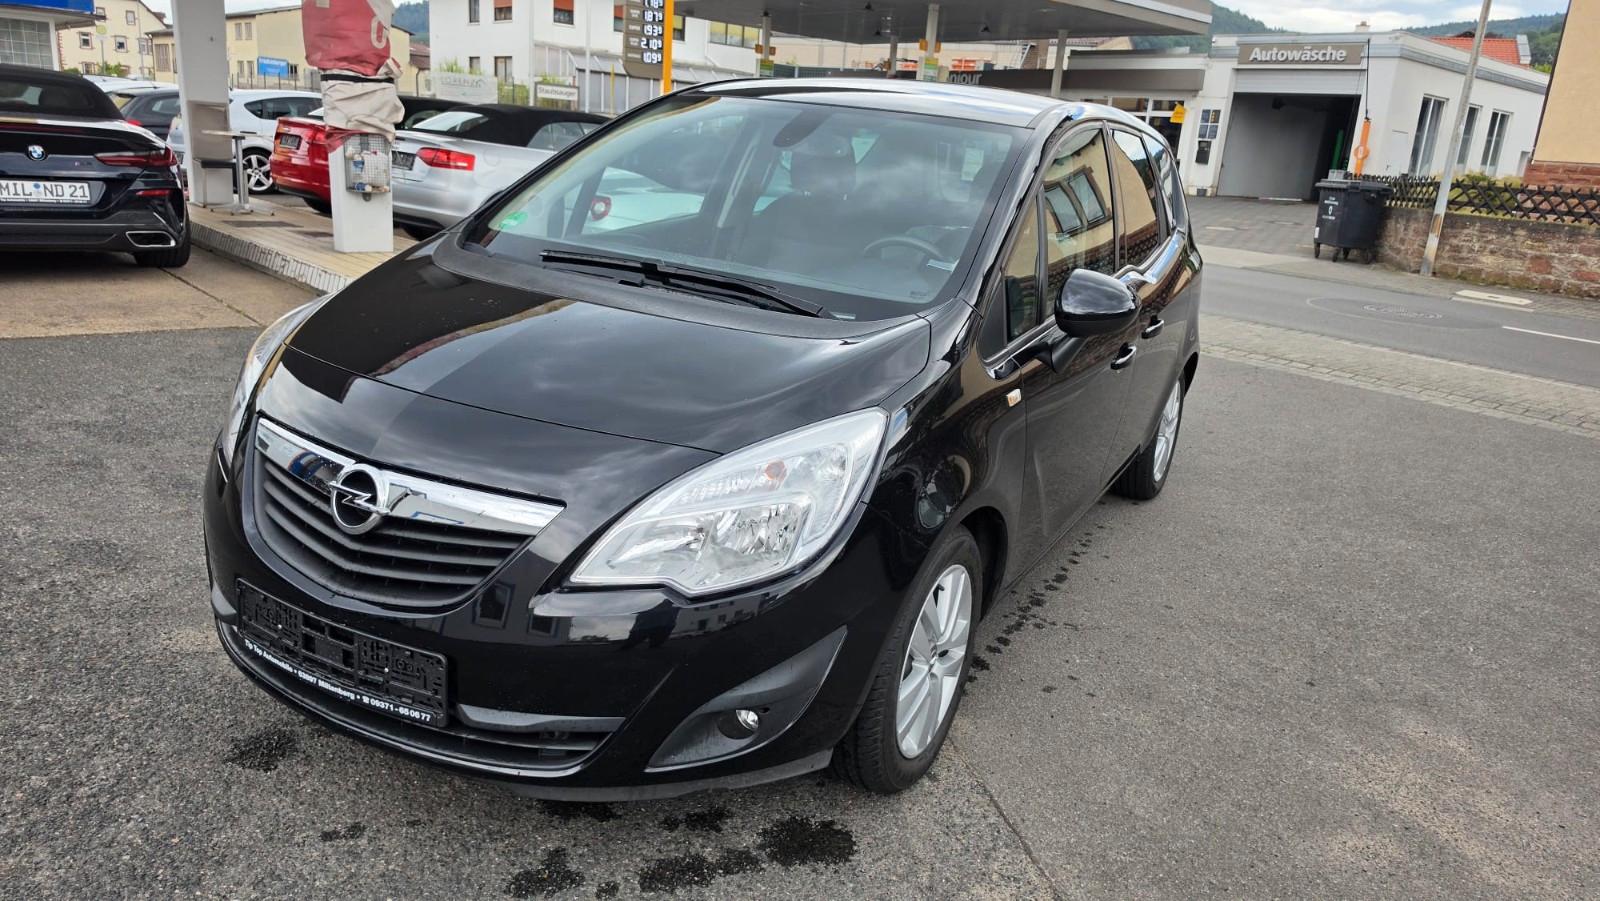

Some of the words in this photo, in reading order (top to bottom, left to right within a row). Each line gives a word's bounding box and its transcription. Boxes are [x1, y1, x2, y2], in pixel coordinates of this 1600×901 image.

[1249, 45, 1347, 62] Autowäsche
[950, 73, 982, 85] njour
[43, 183, 65, 198] ND
[68, 184, 89, 199] 21
